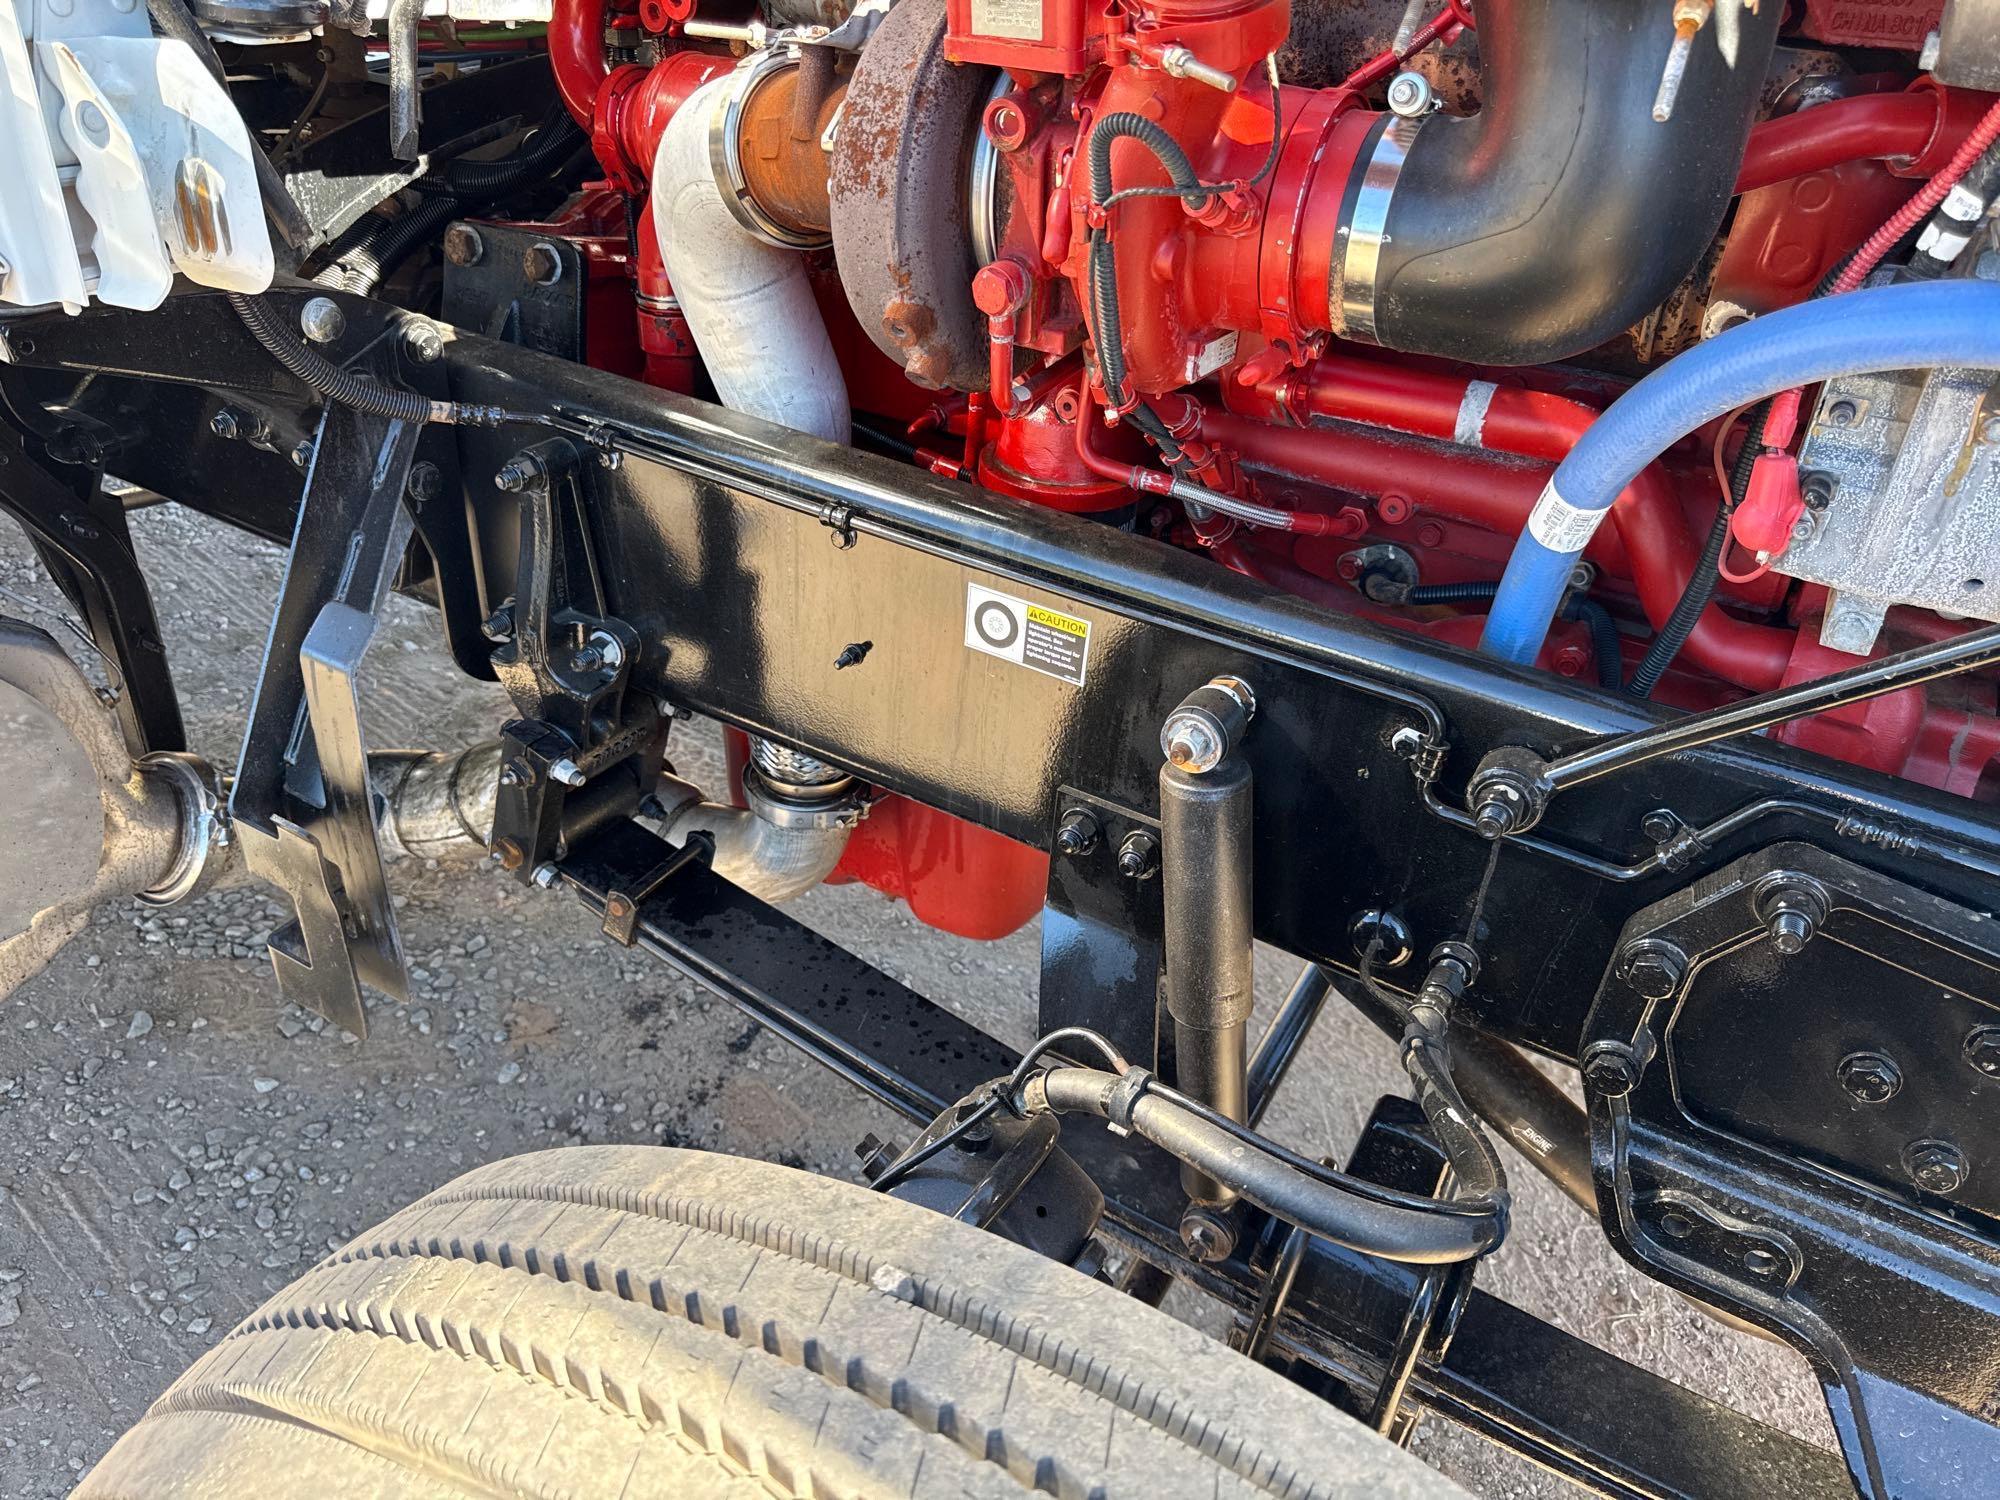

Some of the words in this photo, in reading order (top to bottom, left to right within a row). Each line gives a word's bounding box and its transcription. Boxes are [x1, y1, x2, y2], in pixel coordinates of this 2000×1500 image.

[1831, 12, 1886, 33] CHINA
[1028, 622, 1051, 634] Maintain
[1038, 612, 1086, 635] CAUTION
[1026, 644, 1044, 655] proper
[1044, 649, 1061, 660] torque
[1061, 655, 1071, 663] and
[1053, 646, 1073, 656] manual
[1522, 1127, 1553, 1152] ENGINE
